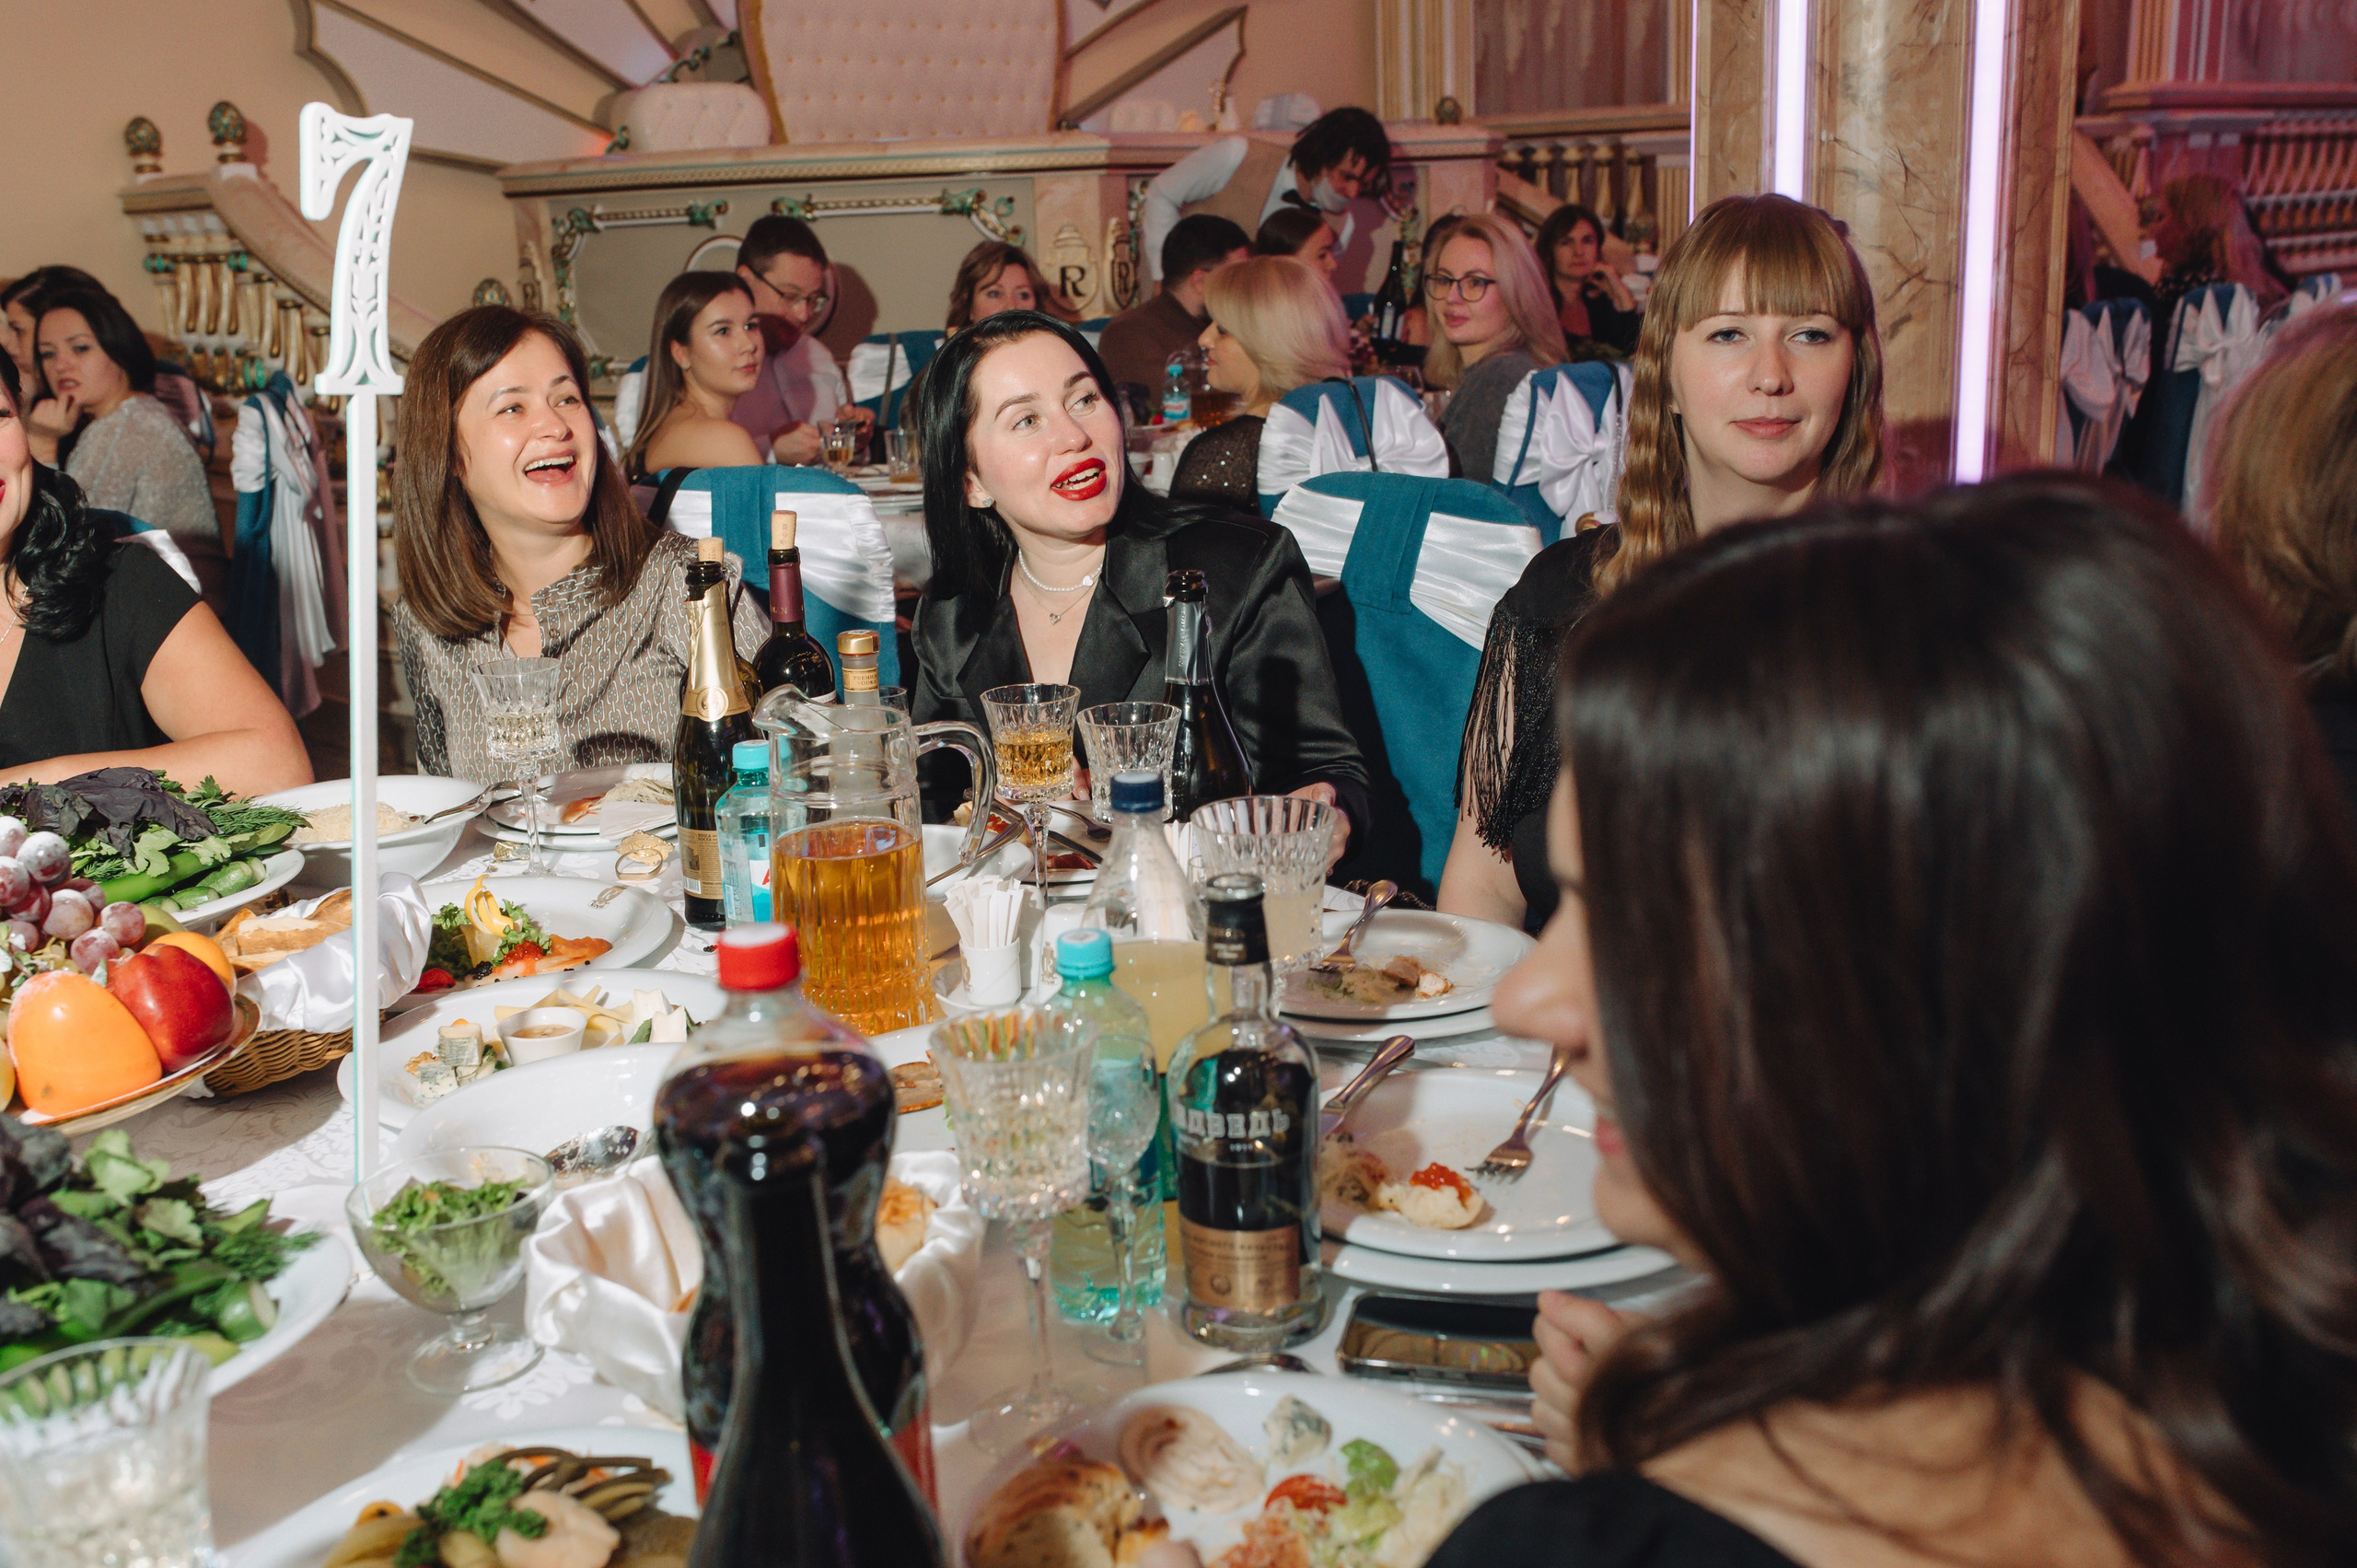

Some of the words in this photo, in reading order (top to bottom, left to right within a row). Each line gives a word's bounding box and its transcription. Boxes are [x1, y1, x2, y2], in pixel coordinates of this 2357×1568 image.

[299, 101, 413, 394] 7
[1060, 265, 1086, 297] R
[1118, 261, 1130, 295] R
